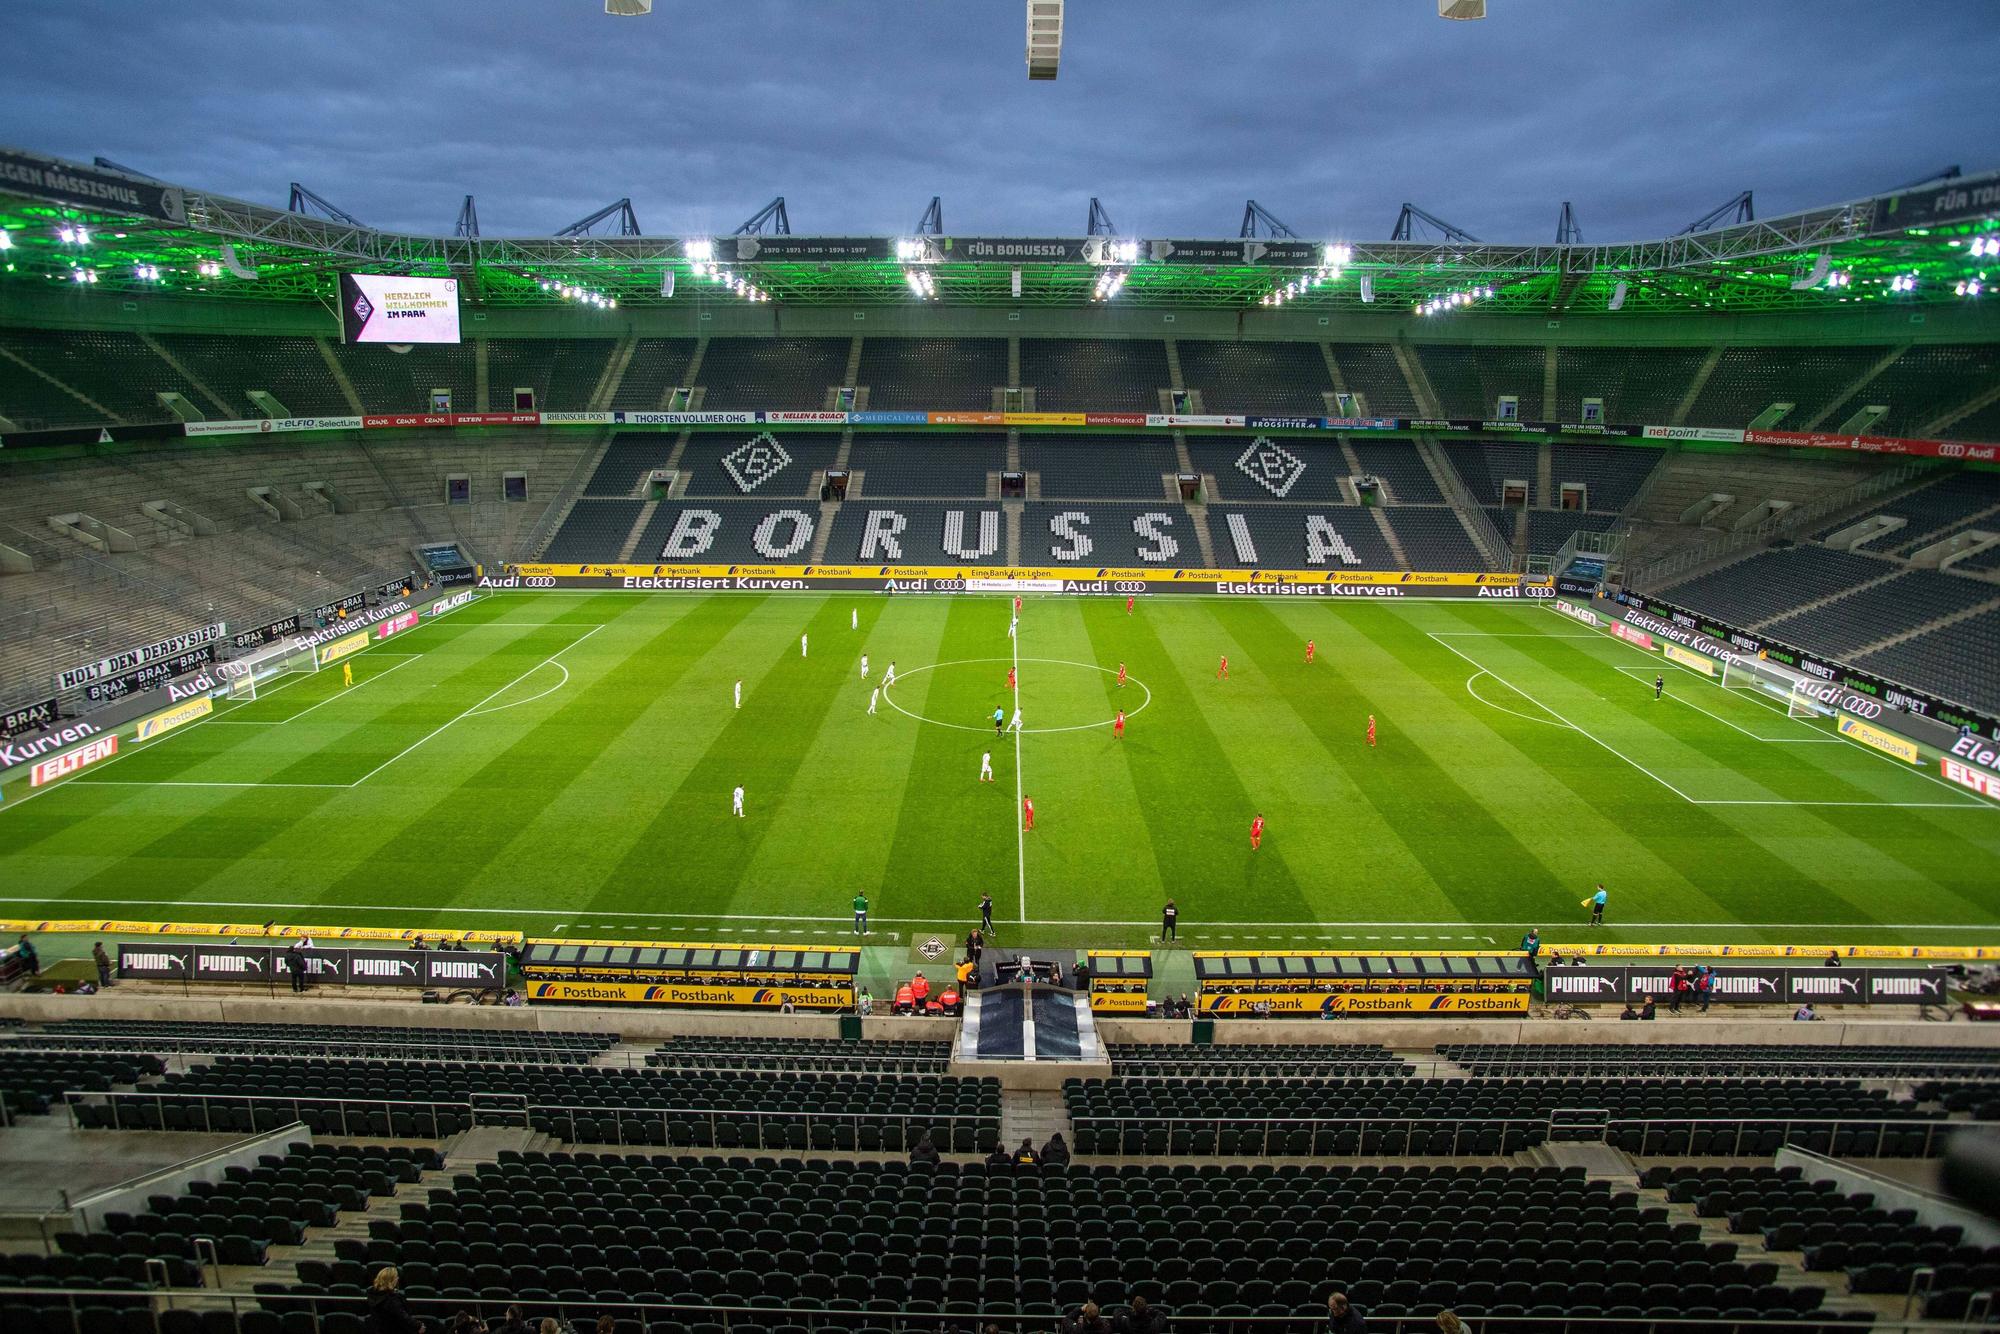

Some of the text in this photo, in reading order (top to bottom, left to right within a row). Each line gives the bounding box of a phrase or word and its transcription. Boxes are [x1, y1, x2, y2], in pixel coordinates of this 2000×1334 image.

[44, 171, 139, 204] RASSISMUS
[969, 242, 1065, 256] FÜR BORUSSIA
[385, 292, 431, 300] HERZLICH
[385, 301, 448, 309] WILLKOMMEN
[387, 310, 426, 319] IM PARK
[319, 419, 360, 427] SelectLine
[547, 413, 607, 421] RHEINISCHE POST
[634, 414, 746, 423] THORSTEN VOLLMER OHG
[819, 412, 845, 420] QUACK
[1252, 421, 1316, 429] BROGSITTER.de
[1649, 427, 1699, 438] netpoint
[1755, 435, 1809, 446] Stadtsparkasse
[1967, 447, 1994, 459] Audi
[661, 509, 1362, 564] BORUSSIA
[594, 567, 626, 575] Postbank
[667, 567, 701, 575] Postbank
[742, 568, 776, 576] Postbank
[386, 580, 404, 592] BRAX
[478, 576, 520, 588] Audi
[623, 577, 809, 589] Elektrisiert Kurven.
[885, 578, 928, 590] Audi
[1065, 580, 1108, 592] Audi
[1216, 582, 1405, 596] Elektrisiert Kurven.
[1478, 585, 1520, 597] Audi
[343, 595, 362, 609] BRAX
[432, 590, 472, 616] FALKEN
[317, 603, 338, 618] BRAX
[1556, 599, 1597, 626] FALKEN
[271, 618, 295, 635] BRAX
[294, 601, 411, 650] Elektrisiert Kurven.
[1672, 613, 1696, 629] UNIBET
[237, 629, 264, 647] BRAX
[1624, 609, 1741, 666] Elektrisiert Kurven.
[1731, 634, 1759, 652] UNIBET
[180, 648, 210, 667] BRAX
[63, 662, 102, 687] HOLT
[108, 652, 139, 673] DEN
[138, 662, 171, 682] BRAX
[1801, 659, 1836, 681] UNIBET
[90, 677, 127, 700] BRAX
[169, 672, 216, 702] Audi
[1794, 677, 1843, 705] Audi
[1885, 690, 1928, 714] UNIBET
[6, 704, 50, 728] BRAX
[163, 702, 208, 728] Postbank
[0, 723, 101, 766] Kurven.
[1862, 730, 1911, 758] Postbank
[42, 736, 113, 783] ELTEN
[116, 924, 150, 932] Postbank
[175, 926, 210, 934] Postbank
[296, 928, 331, 937] Postbank
[356, 930, 392, 939] Postbank
[1548, 946, 1586, 955] Postbank
[1611, 947, 1650, 955] Postbank
[1675, 947, 1713, 956] Postbank
[1738, 948, 1776, 956] Postbank
[123, 953, 169, 969] PUMA
[199, 955, 246, 971] PUMA
[353, 959, 400, 976] PUMA
[431, 961, 478, 978] PUMA
[1551, 976, 1600, 992] PUMA
[1712, 977, 1759, 993] PUMA
[1792, 977, 1841, 993] PUMA
[1872, 978, 1921, 994] PUMA
[563, 987, 626, 998] Postbank
[672, 989, 735, 1002] Postbank
[781, 992, 845, 1004] Postbank
[1349, 998, 1412, 1009] Postbank
[1458, 998, 1521, 1009] Postbank
